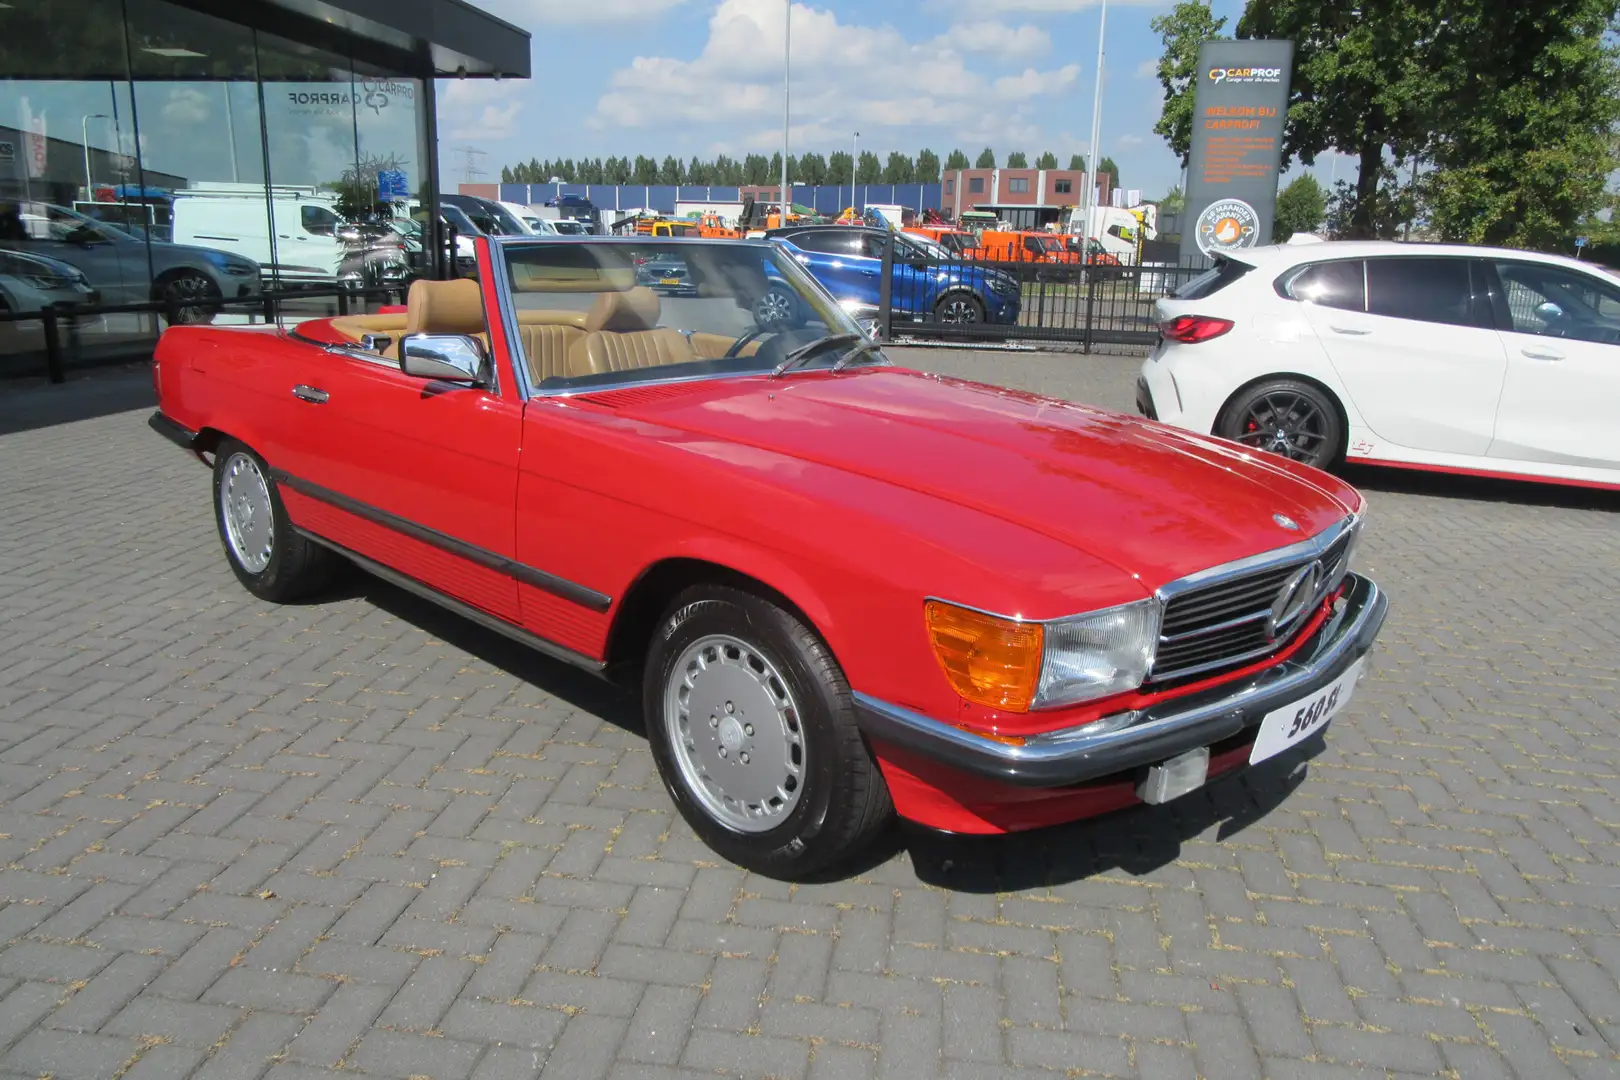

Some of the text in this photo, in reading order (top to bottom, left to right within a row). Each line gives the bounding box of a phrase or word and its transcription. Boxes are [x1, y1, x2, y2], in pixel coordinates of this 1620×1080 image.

[1227, 68, 1281, 77] CARPROF
[1206, 106, 1276, 117] WELKOM BIJ
[1211, 212, 1246, 225] GARANTIE
[1215, 204, 1252, 222] MAANDEN
[1287, 695, 1326, 739] 560
